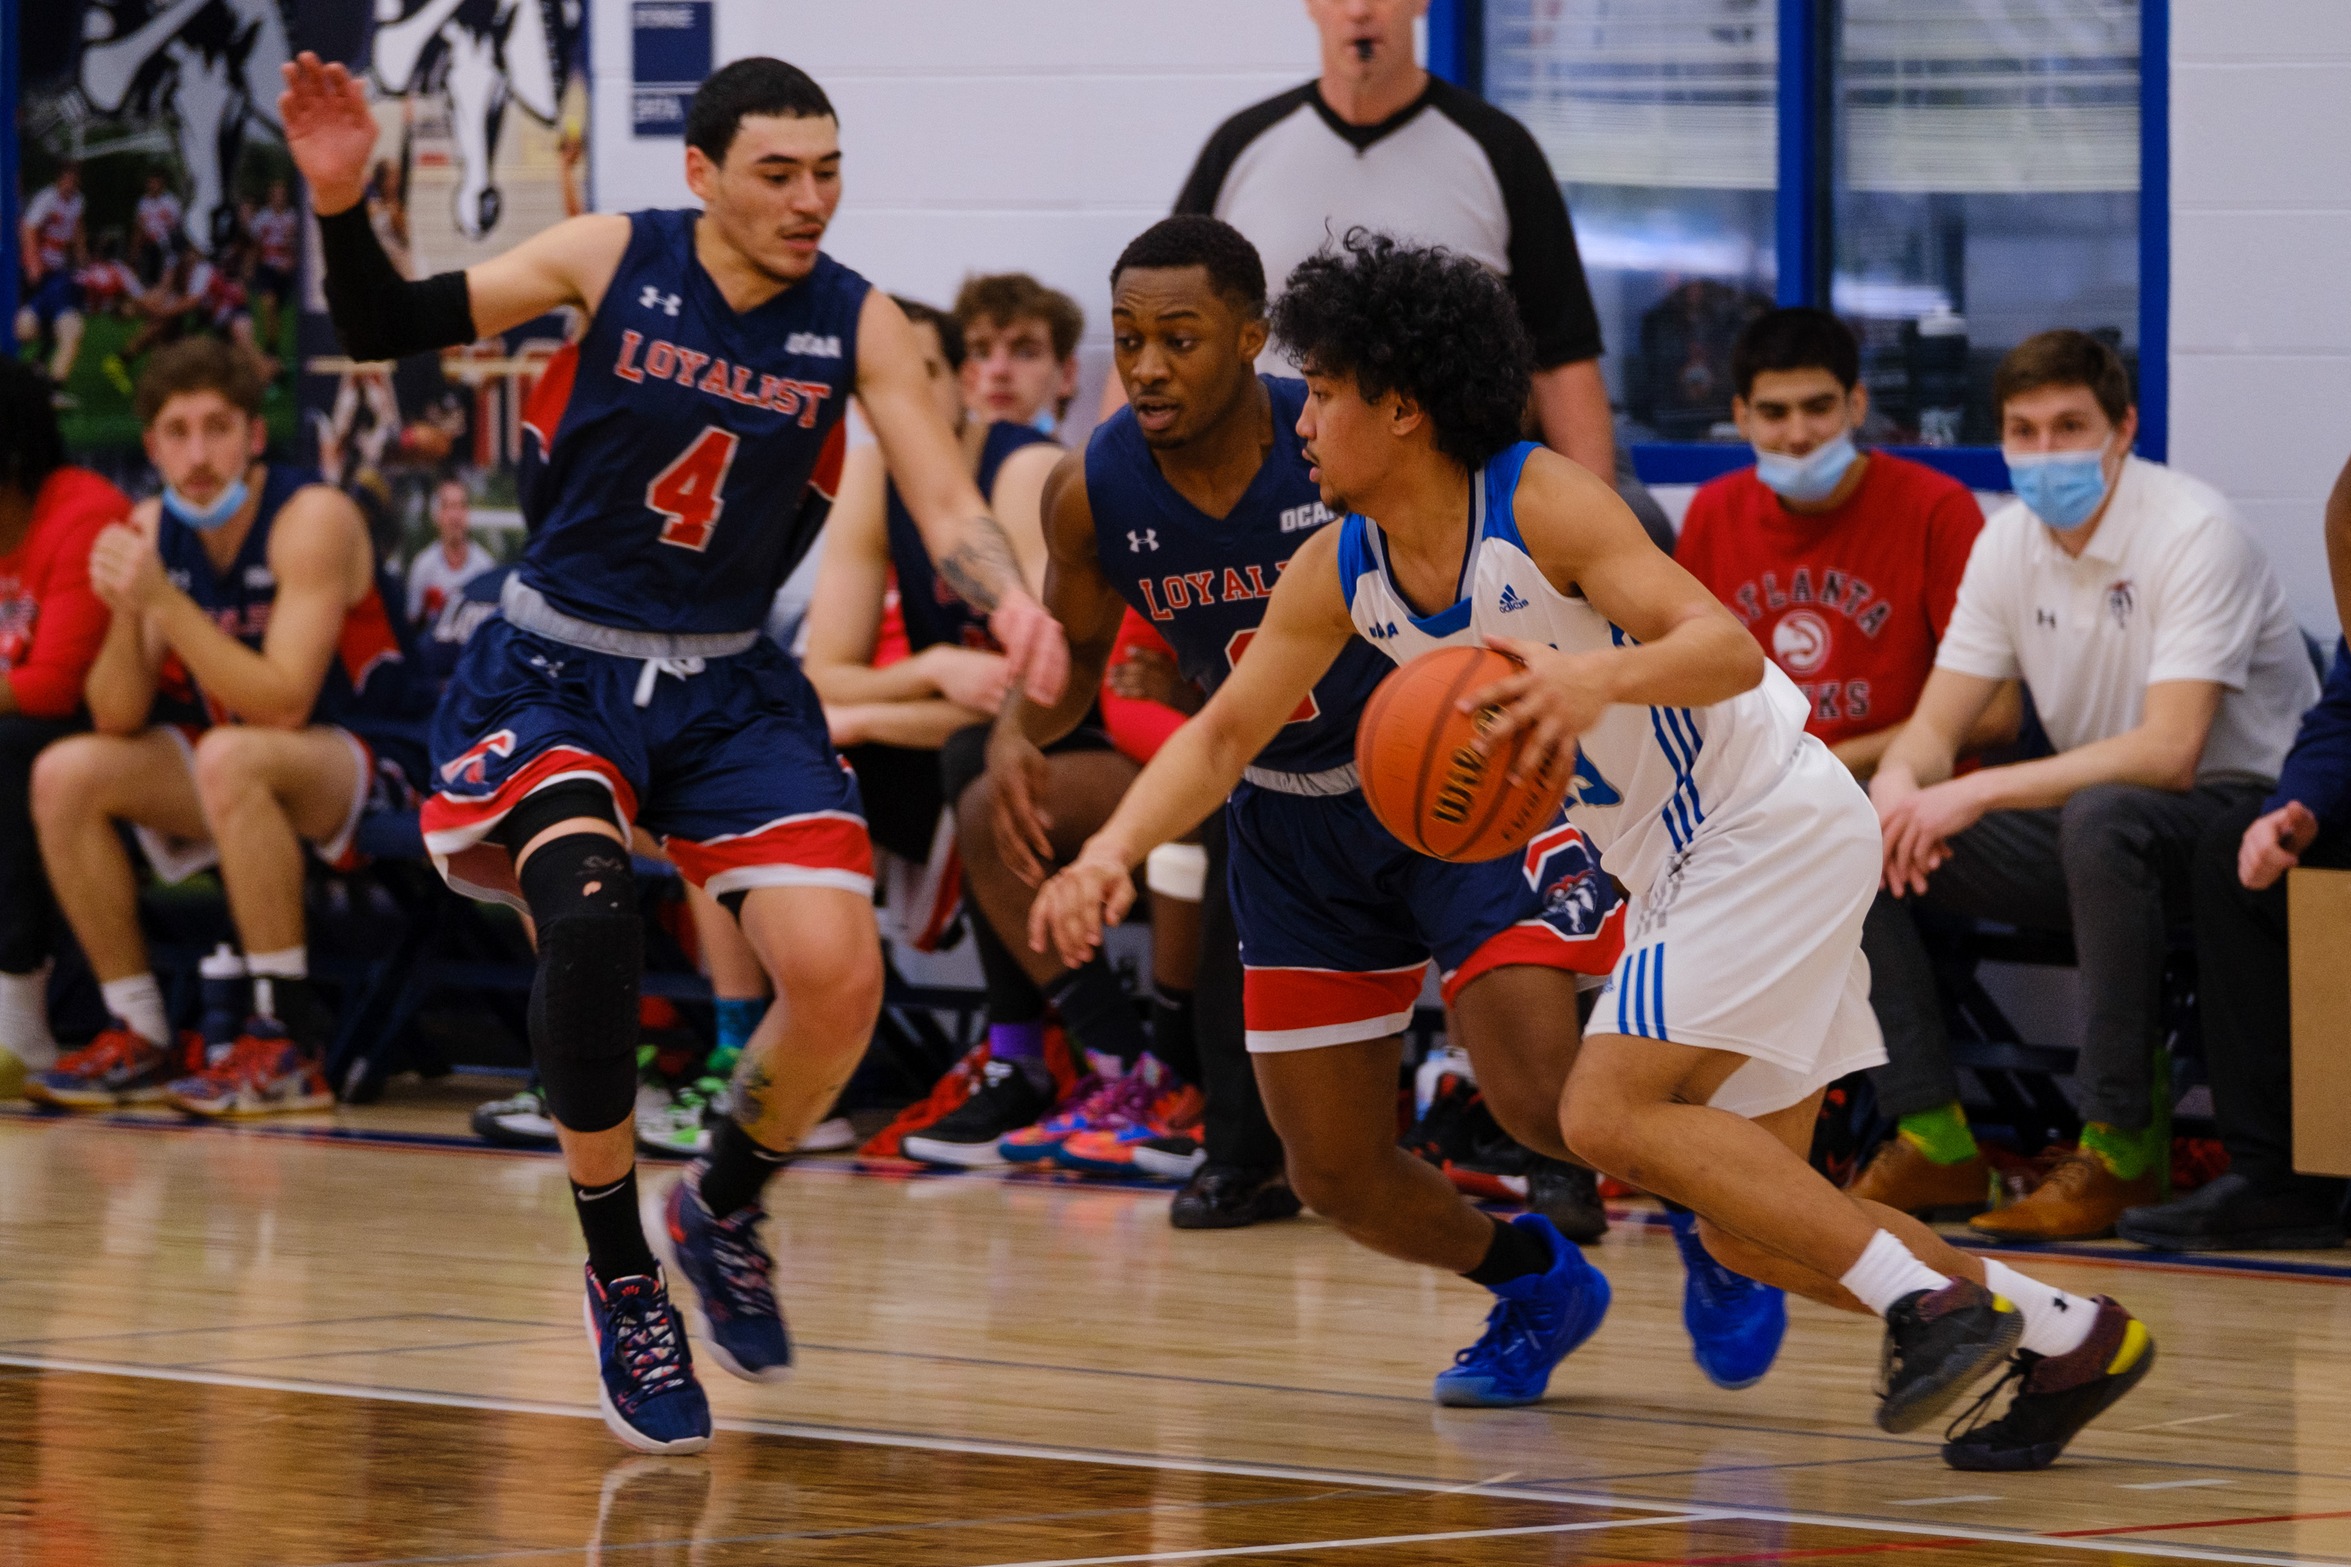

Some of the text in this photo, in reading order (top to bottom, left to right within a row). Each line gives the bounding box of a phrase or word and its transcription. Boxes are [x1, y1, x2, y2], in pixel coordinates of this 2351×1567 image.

[614, 329, 832, 428] LOYALIST
[644, 424, 740, 552] 4
[1138, 560, 1290, 621] LOYAL
[1725, 565, 1892, 639] TLANTA
